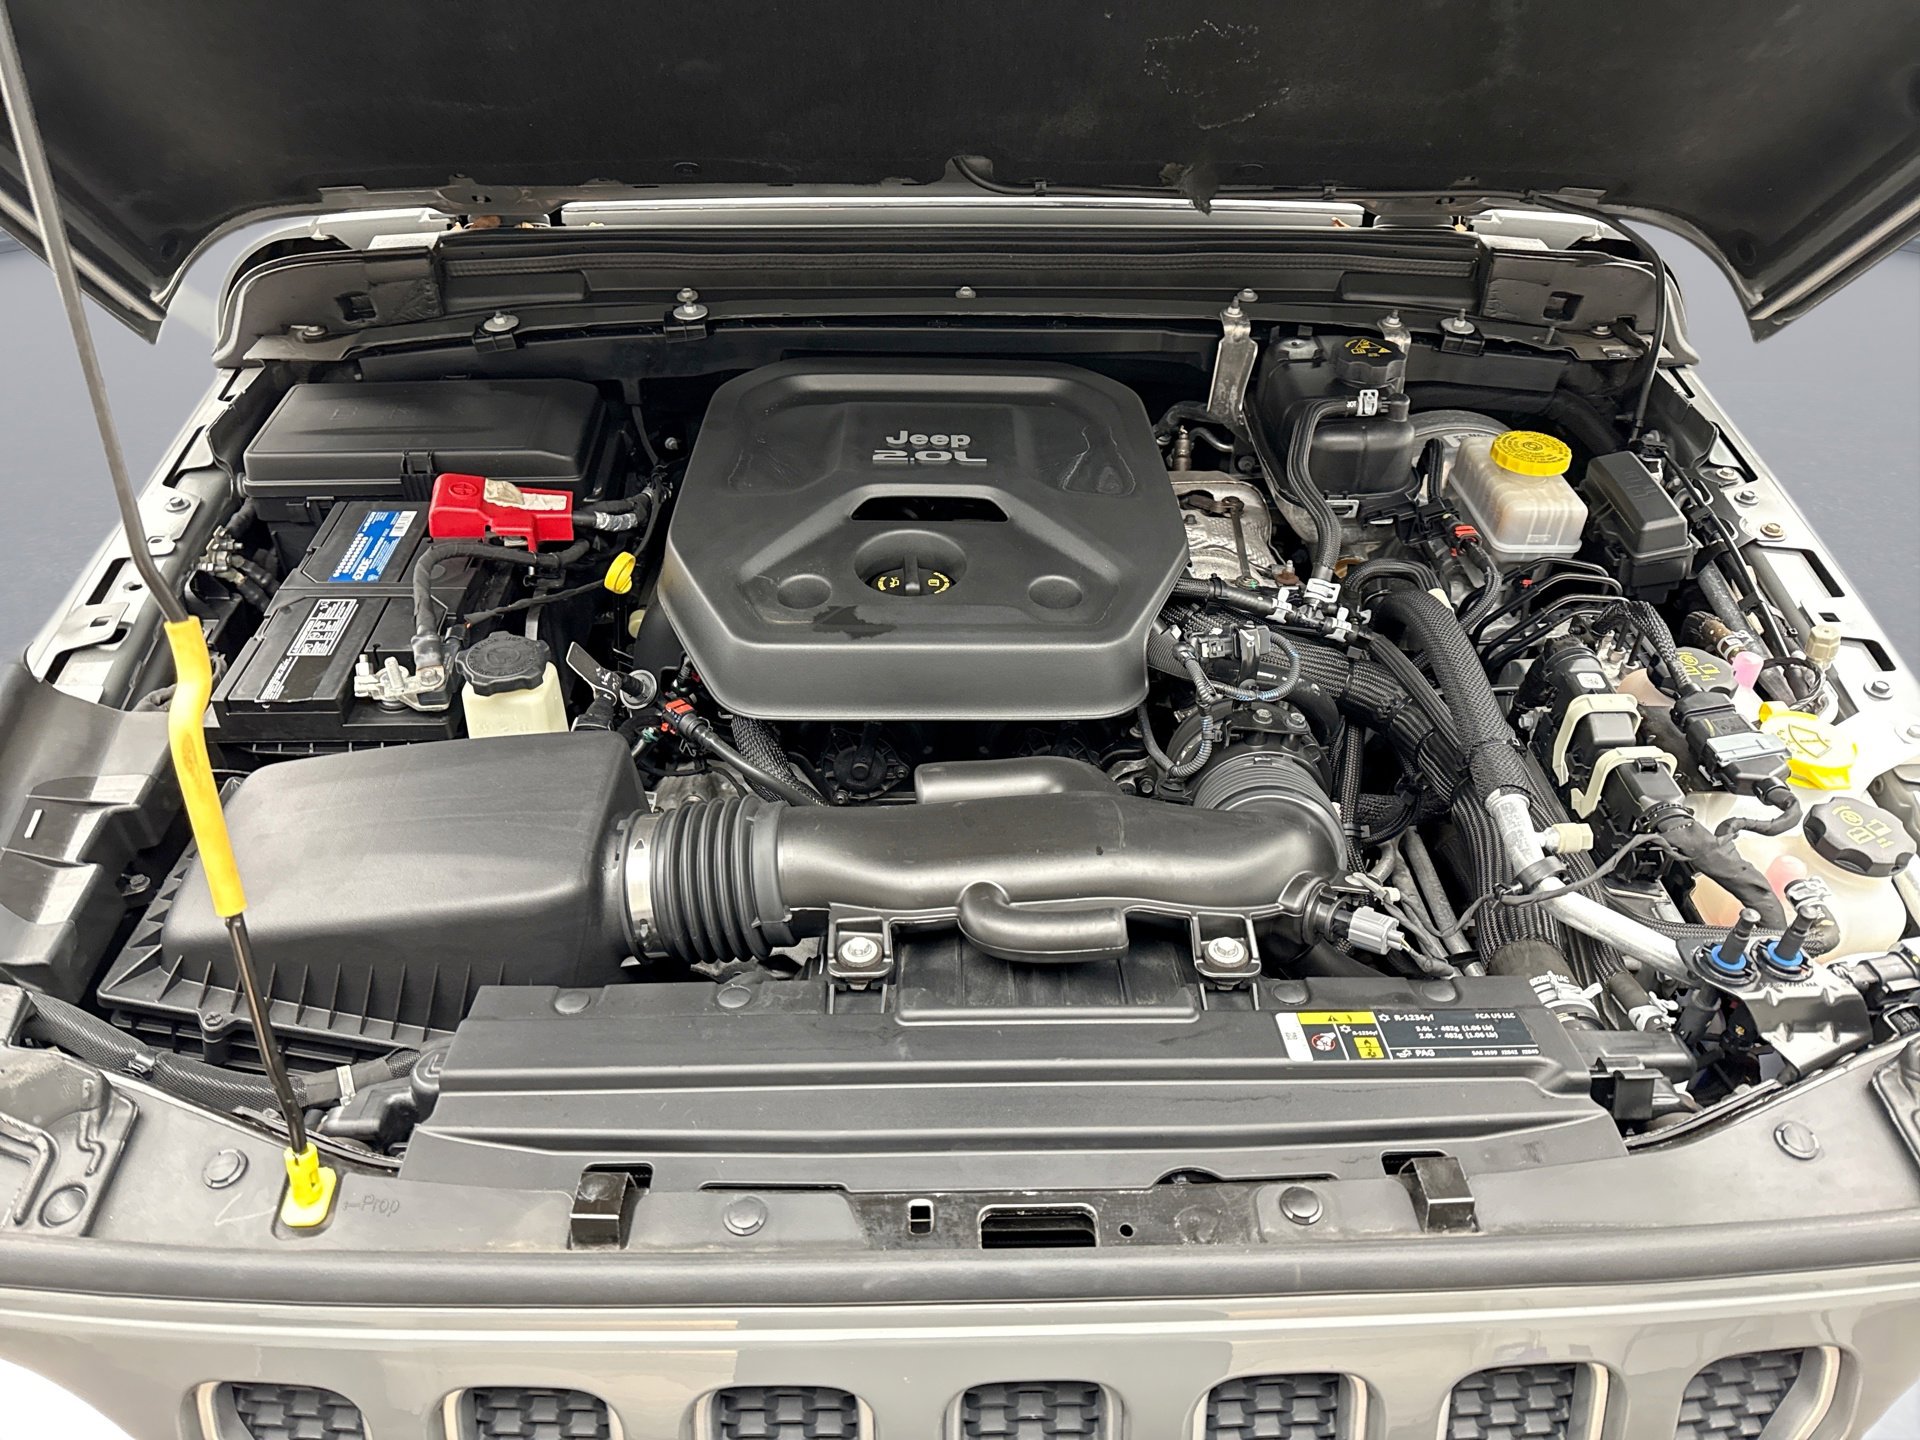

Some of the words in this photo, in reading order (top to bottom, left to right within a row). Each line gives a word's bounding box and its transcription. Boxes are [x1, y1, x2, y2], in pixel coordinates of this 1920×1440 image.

[886, 430, 971, 449] Jeep
[872, 450, 988, 463] 2.0L
[1394, 1013, 1435, 1022] R-1234yf
[361, 1194, 400, 1217] Prop
